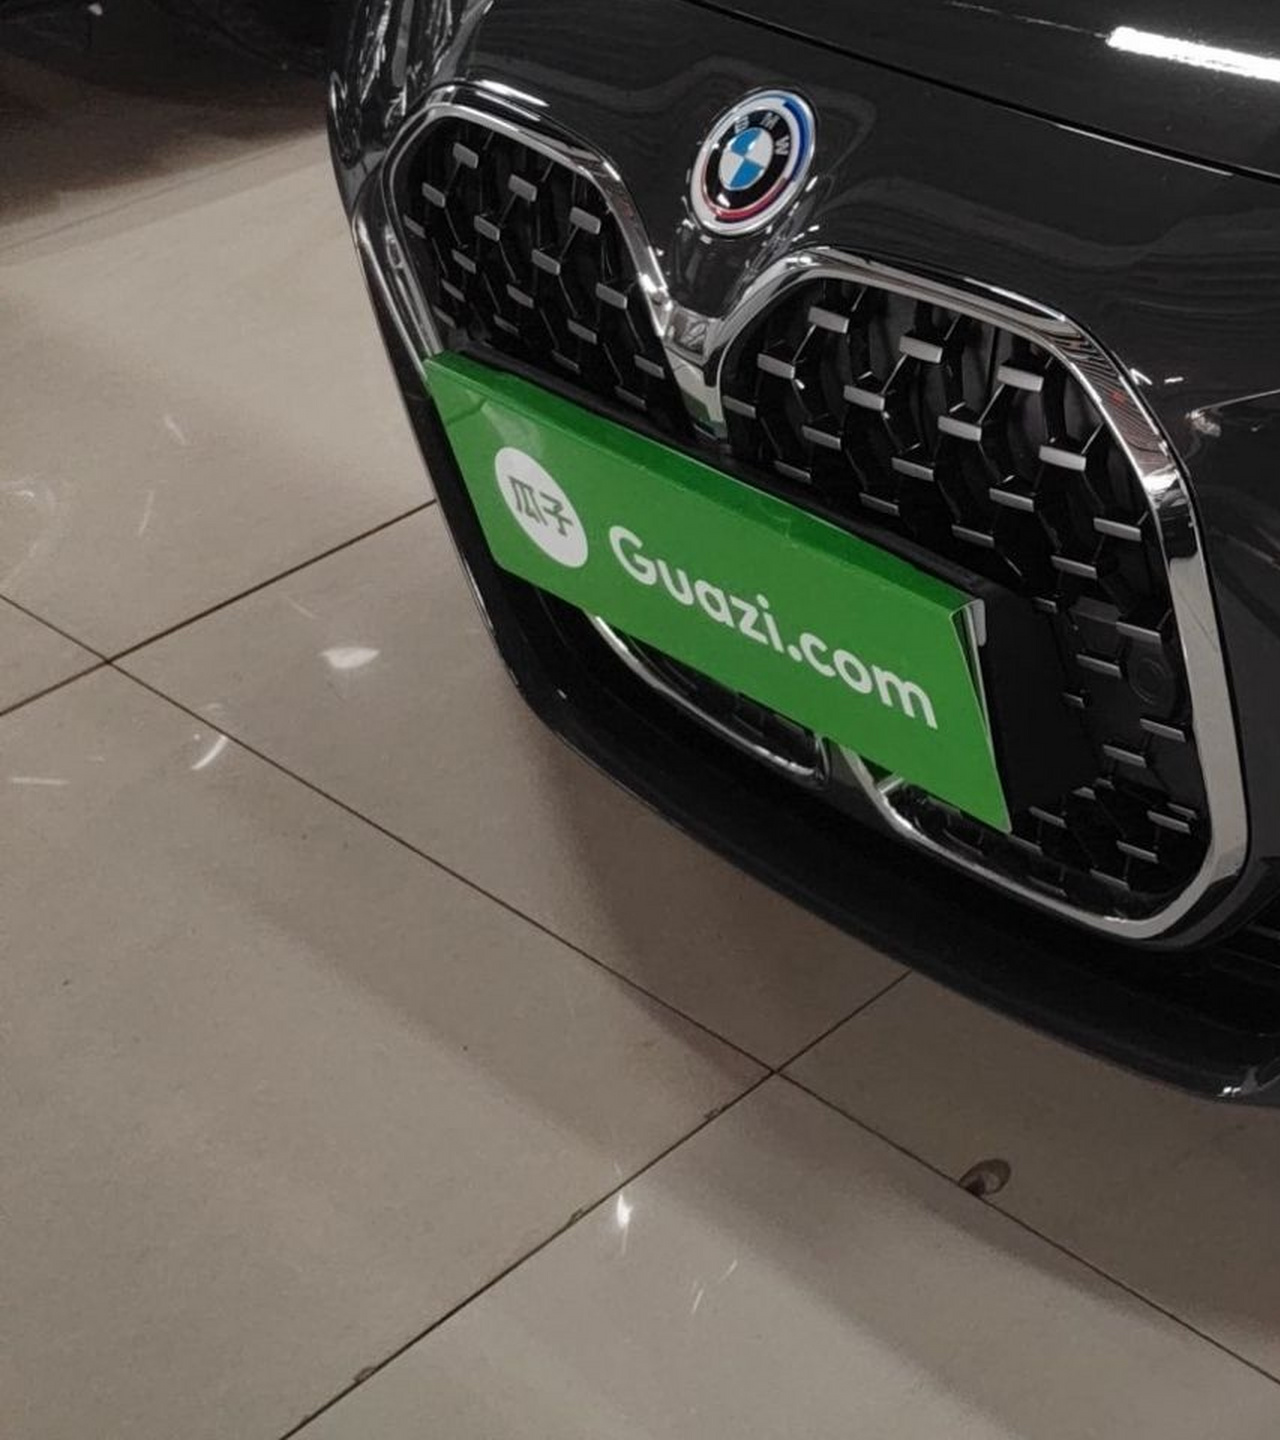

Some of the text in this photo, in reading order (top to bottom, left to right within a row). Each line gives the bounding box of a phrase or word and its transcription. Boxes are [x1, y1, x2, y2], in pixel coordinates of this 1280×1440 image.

[734, 110, 790, 157] BMW
[507, 475, 574, 537] 瓜子
[609, 525, 938, 730] Guazi.com
